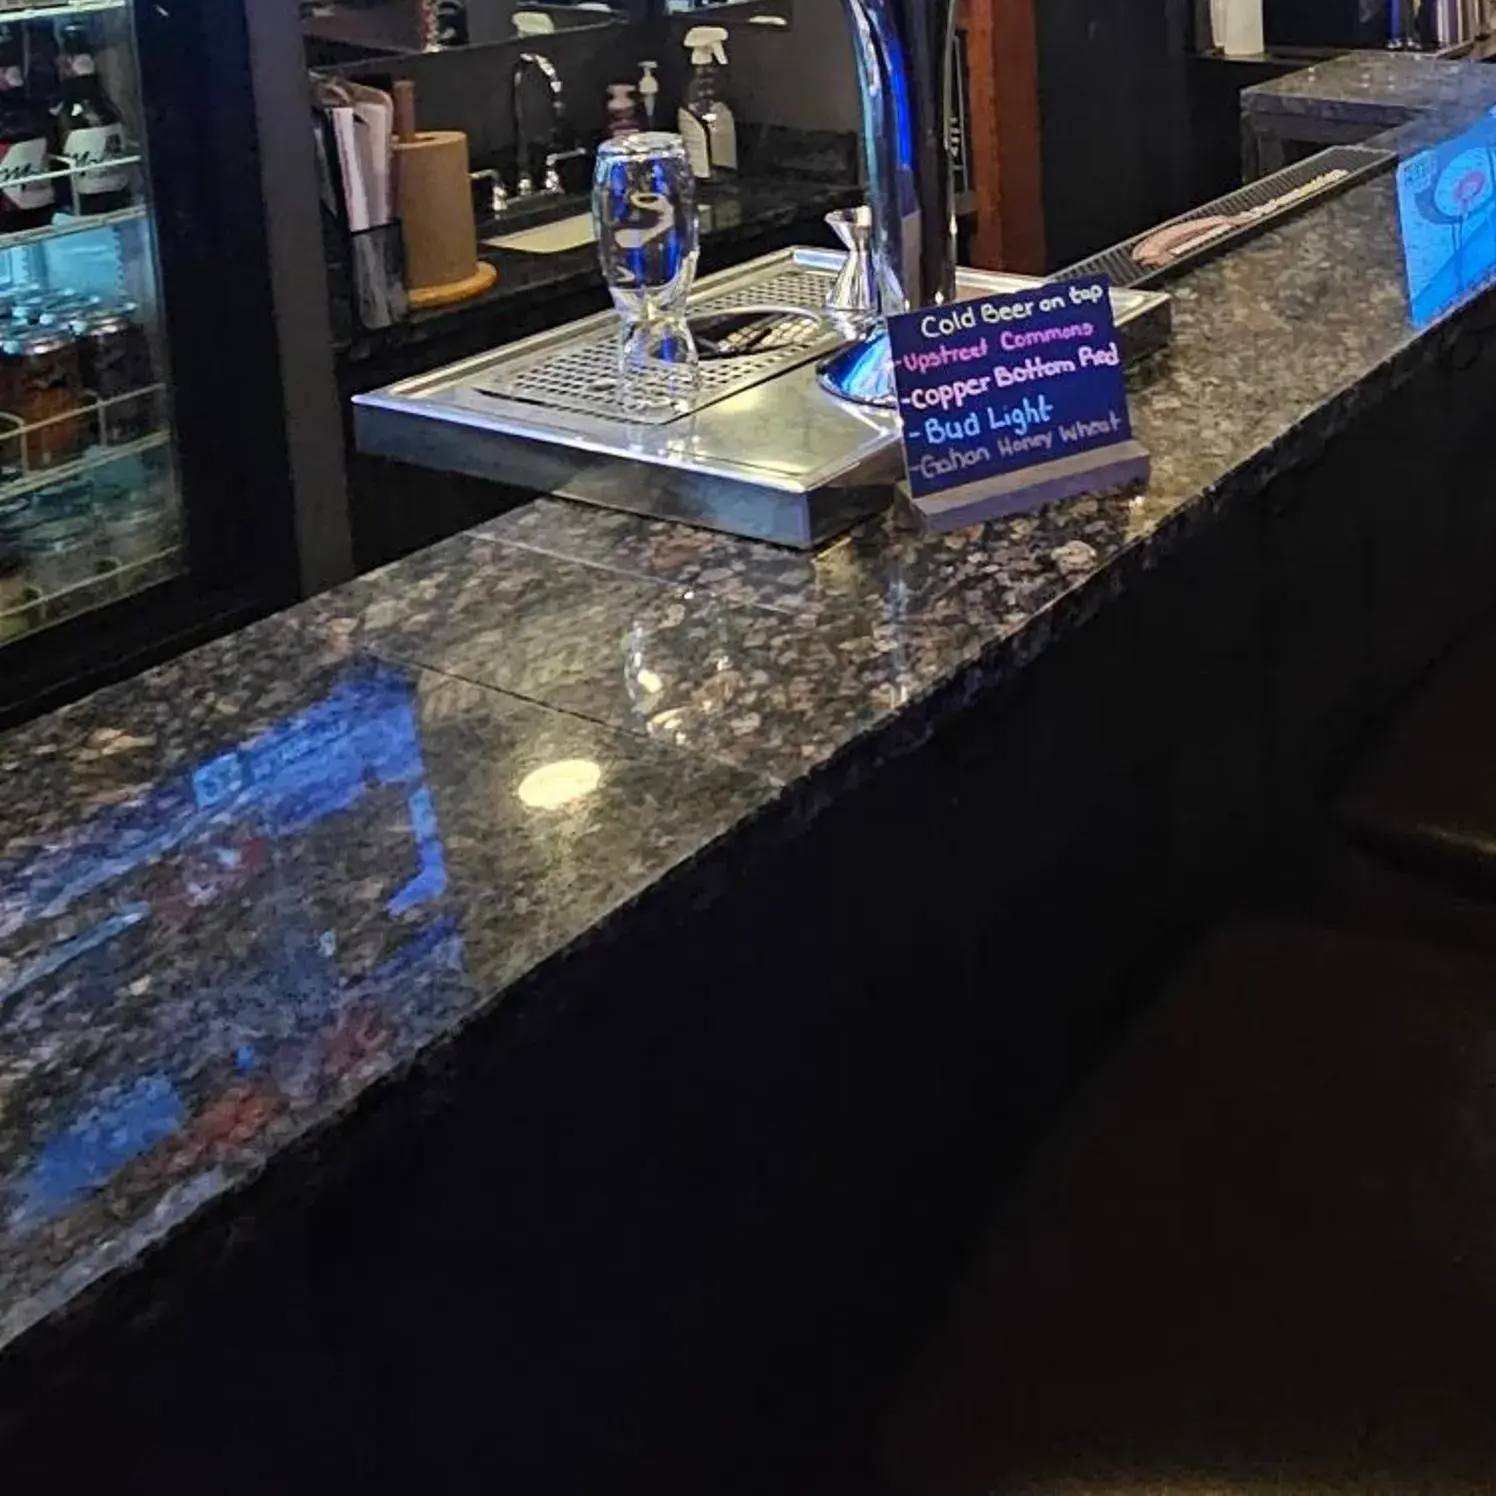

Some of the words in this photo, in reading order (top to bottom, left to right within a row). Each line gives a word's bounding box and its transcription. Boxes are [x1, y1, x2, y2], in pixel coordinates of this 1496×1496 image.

[920, 306, 977, 338] Cold
[981, 300, 1034, 324] Beer
[1039, 294, 1065, 312] on
[1069, 284, 1104, 304] tap
[1000, 322, 1095, 351] Commons
[994, 355, 1076, 388] Bottom
[988, 394, 1054, 436] Light
[996, 431, 1053, 457] Honey
[1058, 411, 1123, 443] Wheat
